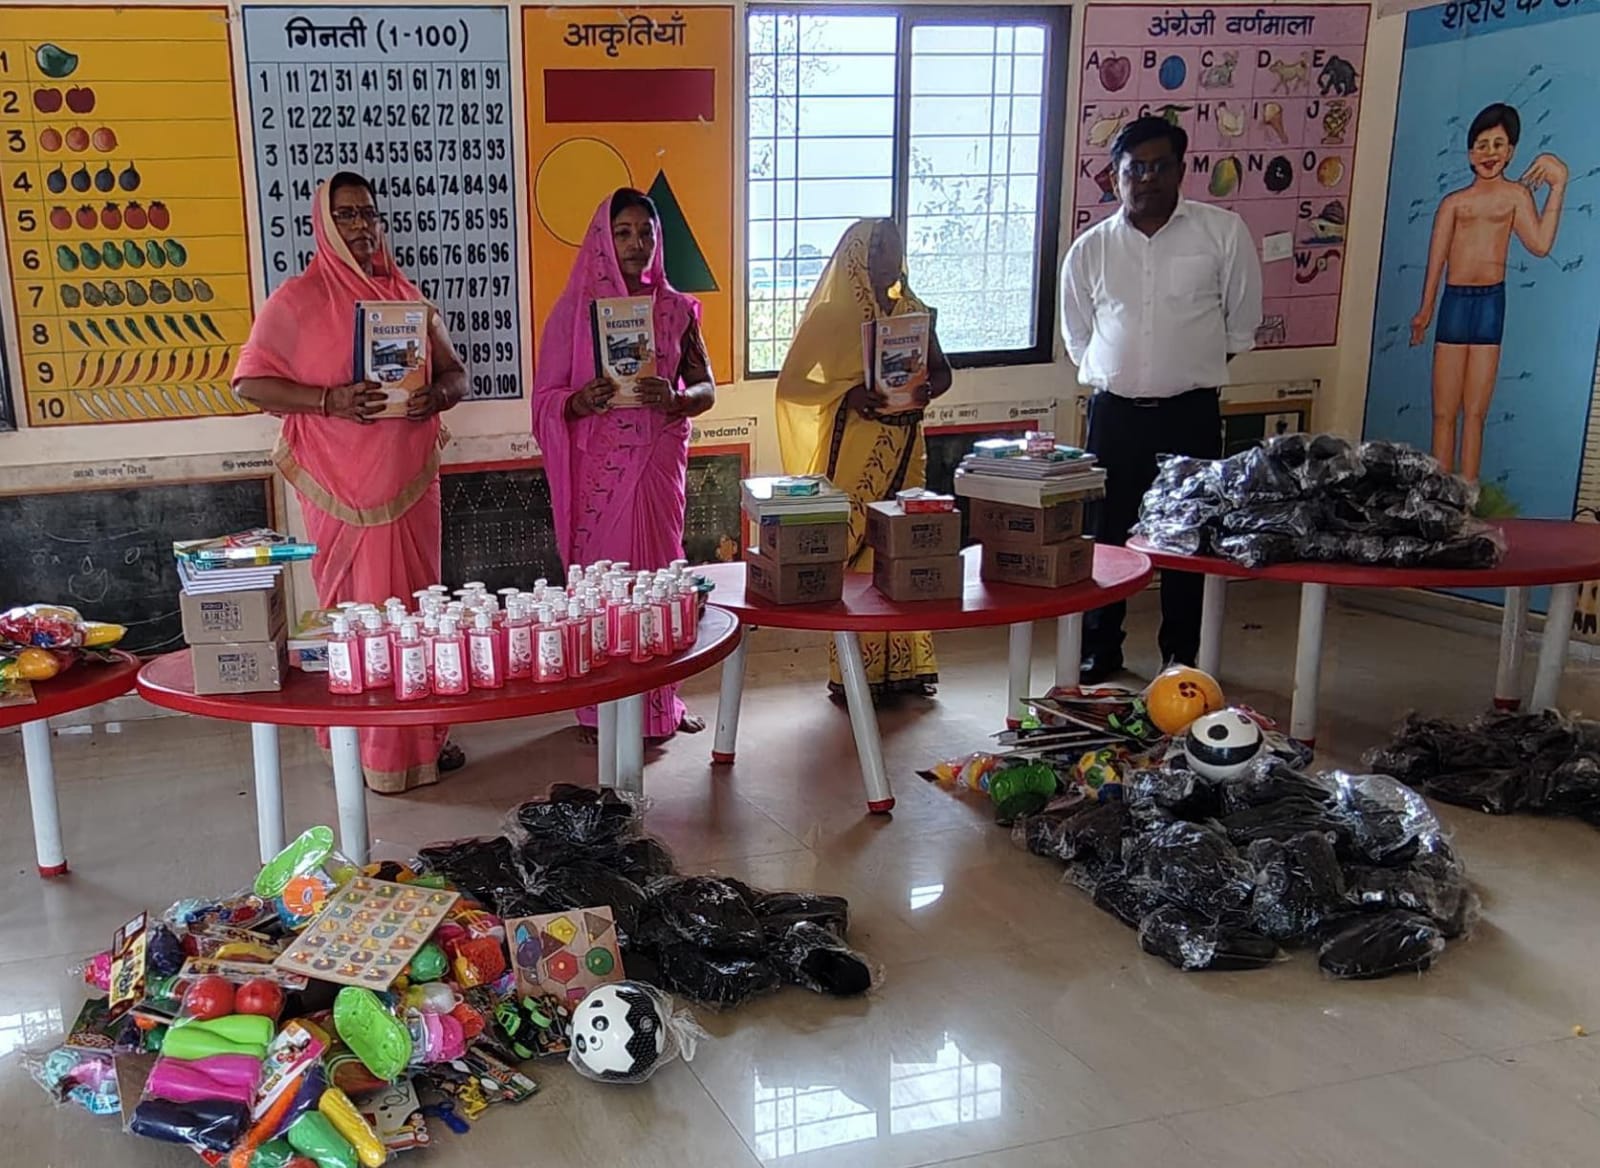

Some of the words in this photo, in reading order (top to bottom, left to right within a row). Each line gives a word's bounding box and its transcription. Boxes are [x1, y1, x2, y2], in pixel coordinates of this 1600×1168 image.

[564, 11, 687, 57] आकृतियाँ
[1147, 10, 1215, 37] अंग्रेजी
[1226, 10, 1315, 36] वर्णमाला
[285, 17, 366, 48] गिनती
[377, 19, 469, 53] (1-100)
[0, 51, 8, 73] 1
[1086, 51, 1100, 70] A
[1144, 51, 1156, 68] B
[1202, 51, 1213, 67] C
[1257, 51, 1271, 68] D
[1313, 50, 1325, 67] E
[261, 71, 267, 92] 1
[287, 71, 299, 92] 11
[310, 70, 327, 92] 21
[336, 70, 351, 91] 31
[362, 70, 377, 90] 41
[388, 69, 402, 91] 51
[413, 69, 427, 90] 61
[437, 69, 451, 89] 71
[461, 68, 475, 89] 81
[486, 69, 499, 89] 91
[3, 91, 19, 113] 2
[1083, 106, 1096, 123] F
[1138, 105, 1150, 118] G
[1197, 104, 1209, 121] H
[1254, 104, 1258, 120] I
[1306, 102, 1319, 118] J
[263, 107, 274, 128] 2
[288, 107, 304, 128] 12
[312, 106, 331, 128] 22
[337, 106, 355, 127] 32
[363, 105, 382, 126] 42
[387, 105, 405, 126] 52
[412, 104, 429, 126] 62
[437, 104, 453, 126] 72
[462, 103, 479, 125] 82
[486, 103, 503, 124] 92
[7, 130, 26, 152] 3
[266, 145, 277, 166] 3
[290, 144, 308, 165] 13
[314, 143, 333, 164] 23
[339, 143, 357, 164] 33
[365, 142, 384, 163] 43
[390, 142, 408, 163] 53
[414, 141, 432, 162] 63
[438, 140, 456, 161] 73
[463, 139, 481, 160] 83
[487, 139, 505, 160] 93
[1194, 156, 1209, 173] M
[1249, 155, 1263, 172] N
[1303, 151, 1316, 171] O
[1080, 160, 1093, 178] K
[13, 172, 32, 193] 4
[269, 181, 283, 201] 4
[293, 180, 311, 200] 14
[391, 177, 412, 197] 54
[416, 176, 435, 196] 64
[440, 175, 459, 195] 74
[464, 175, 483, 194] 84
[489, 174, 507, 194] 94
[18, 210, 36, 231] 5
[393, 211, 412, 233] 55
[418, 211, 436, 232] 65
[442, 210, 459, 231] 75
[466, 209, 484, 230] 85
[490, 208, 508, 229] 95
[1076, 211, 1091, 229] P
[1299, 202, 1311, 218] S
[271, 216, 284, 237] 5
[295, 216, 313, 236] 15
[23, 250, 40, 269] 6
[274, 251, 287, 272] 6
[395, 246, 414, 267] 56
[420, 246, 438, 266] 66
[443, 245, 461, 264] 76
[468, 244, 486, 264] 86
[491, 242, 509, 262] 96
[1296, 253, 1311, 268] W
[28, 287, 44, 307] 7
[421, 279, 439, 300] 67
[445, 278, 464, 299] 77
[469, 277, 487, 297] 87
[493, 276, 509, 296] 97
[373, 326, 416, 335] REGISTER
[447, 311, 465, 332] 78
[472, 311, 489, 331] 88
[495, 310, 511, 329] 98
[33, 324, 50, 344] 8
[472, 343, 490, 364] 89
[496, 342, 513, 362] 99
[38, 363, 53, 383] 9
[473, 375, 492, 395] 90
[496, 374, 516, 394] 100
[38, 399, 65, 419] 10
[703, 426, 748, 438] vedanta
[236, 459, 273, 468] vedanta
